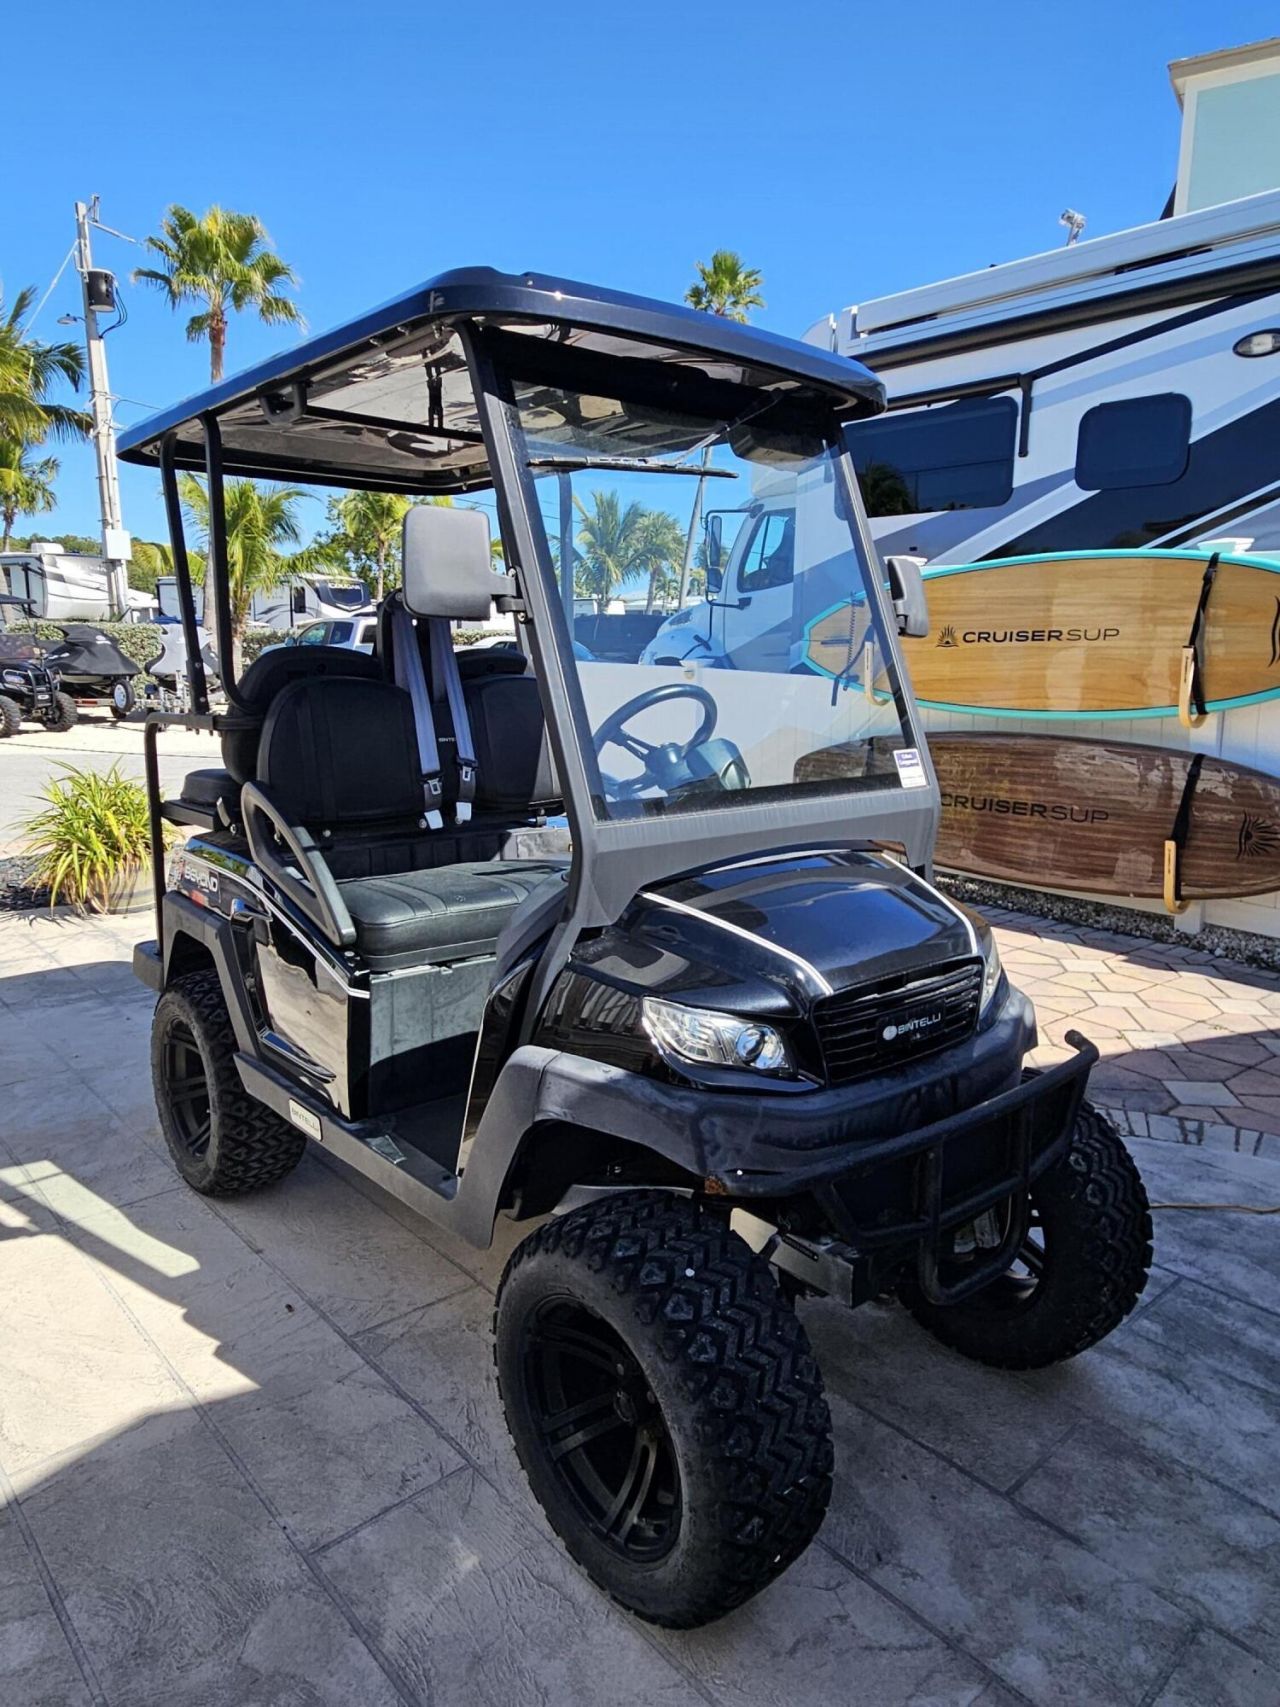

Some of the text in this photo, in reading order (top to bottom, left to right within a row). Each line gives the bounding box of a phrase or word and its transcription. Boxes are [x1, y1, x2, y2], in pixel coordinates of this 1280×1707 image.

[963, 628, 1120, 643] CRUISERSUP
[941, 793, 1109, 824] CRUISERSUP
[897, 1012, 941, 1035] BINTELLI
